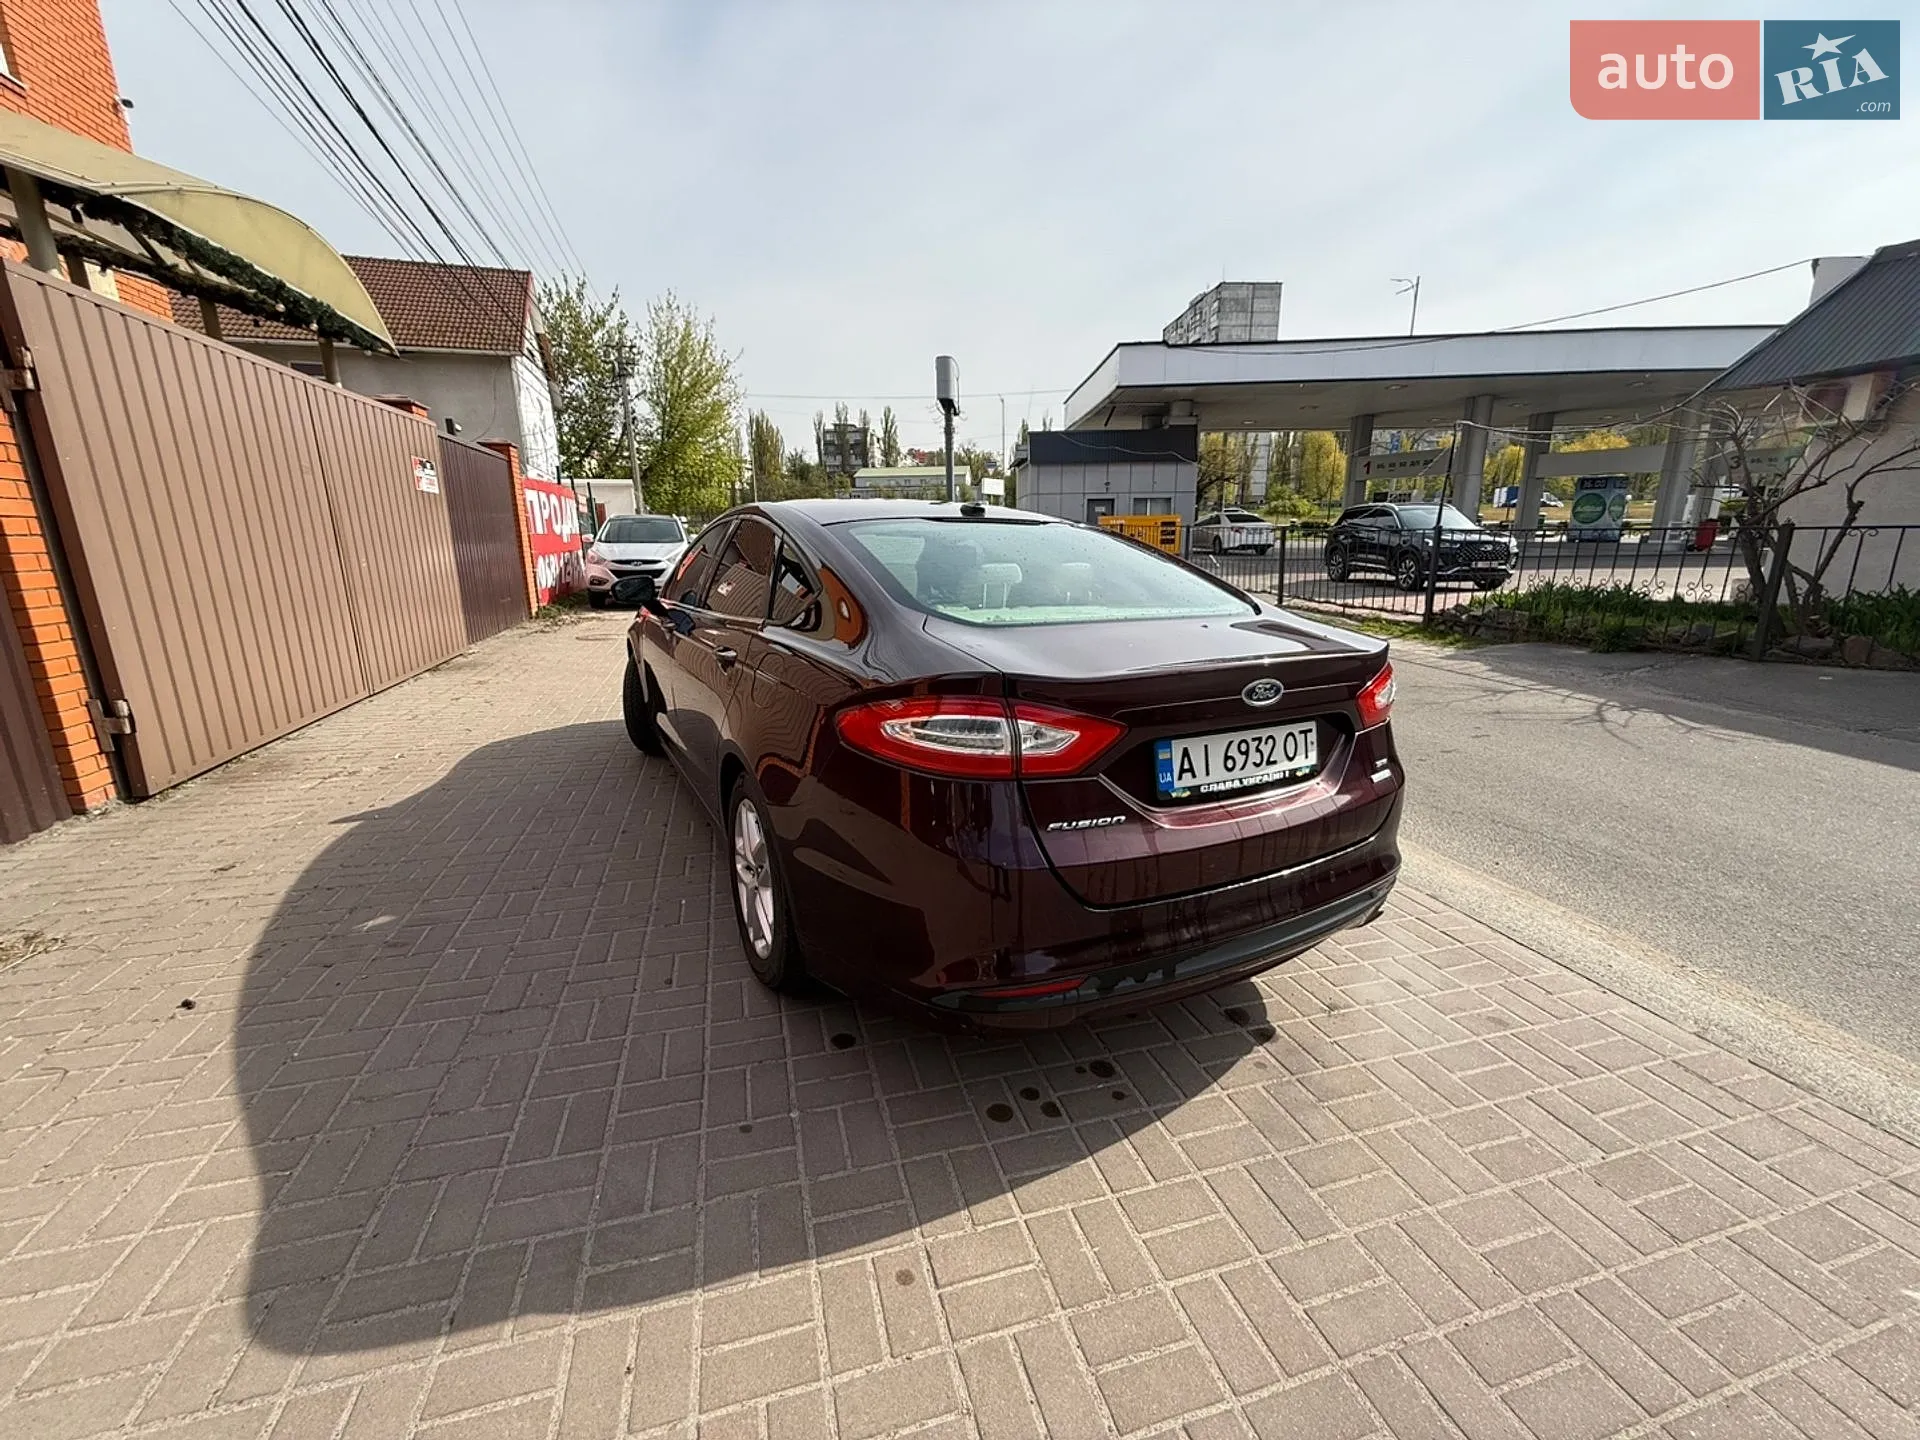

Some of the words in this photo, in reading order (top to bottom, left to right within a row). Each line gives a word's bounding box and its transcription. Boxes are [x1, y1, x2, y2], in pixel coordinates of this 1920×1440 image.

[1177, 744, 1210, 781] AI
[1223, 734, 1278, 773] 6932
[1283, 728, 1313, 762] OT
[1159, 772, 1172, 783] UA
[1046, 815, 1126, 831] FUSION
